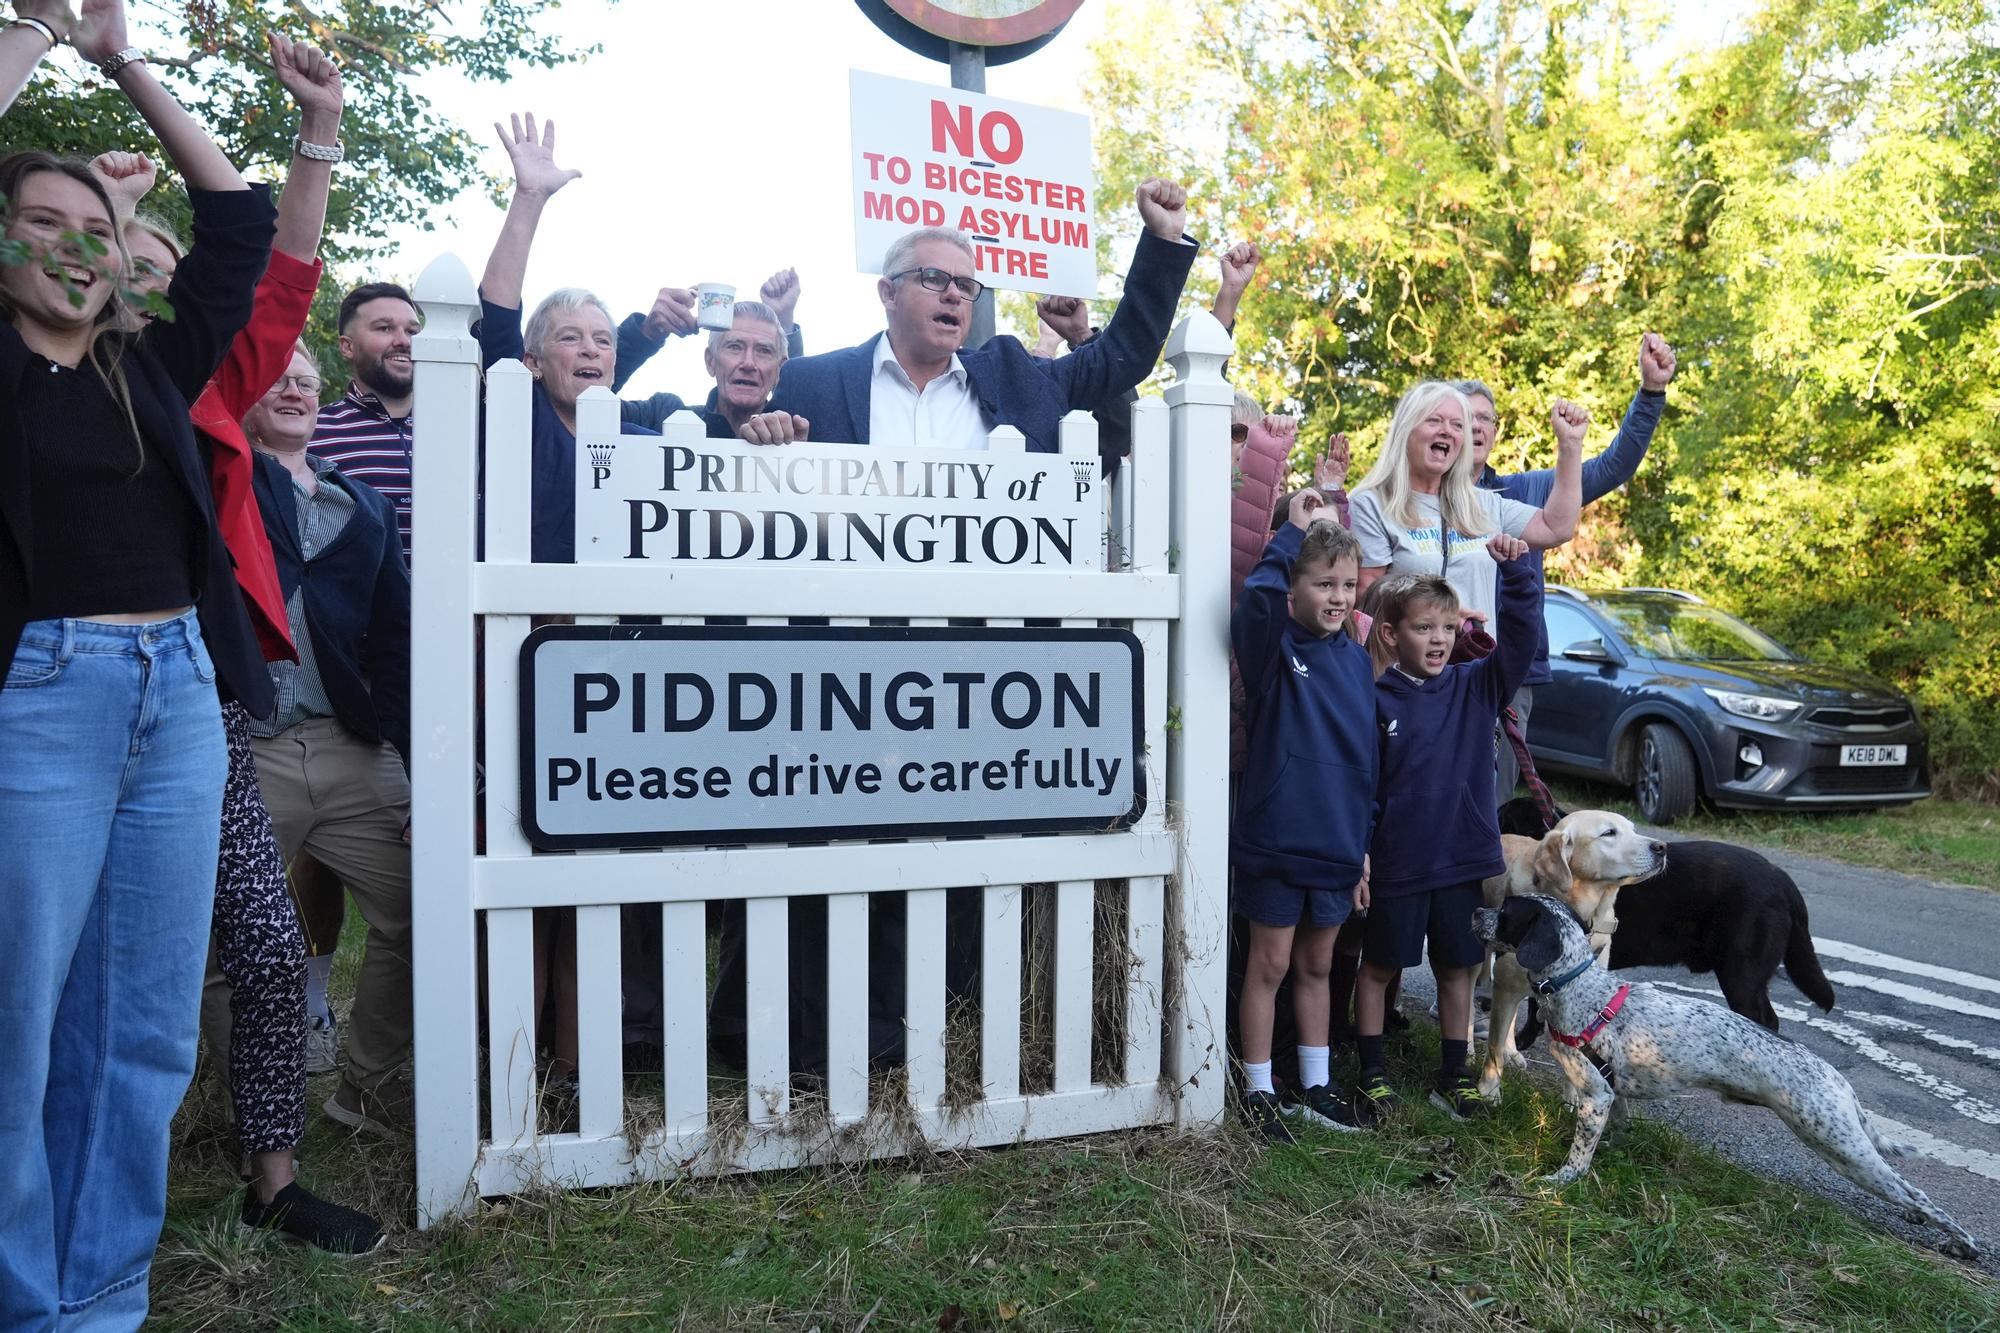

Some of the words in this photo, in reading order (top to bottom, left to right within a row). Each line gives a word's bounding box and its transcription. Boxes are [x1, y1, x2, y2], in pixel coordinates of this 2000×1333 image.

[930, 99, 1024, 165] NO
[863, 152, 912, 185] TO
[924, 161, 1086, 213] BICESTER
[863, 191, 946, 227] MOD
[958, 206, 1089, 249] ASYLUM
[658, 445, 995, 500] PRINCIPALITY
[1007, 471, 1048, 502] of
[623, 498, 1078, 565] PIDDINGTON
[573, 670, 1101, 734] PIDDINGTON
[548, 757, 733, 802] Please
[748, 753, 883, 798] drive
[898, 747, 1123, 797] carefully
[1848, 748, 1875, 762] KE18
[1879, 748, 1899, 762] DWL
